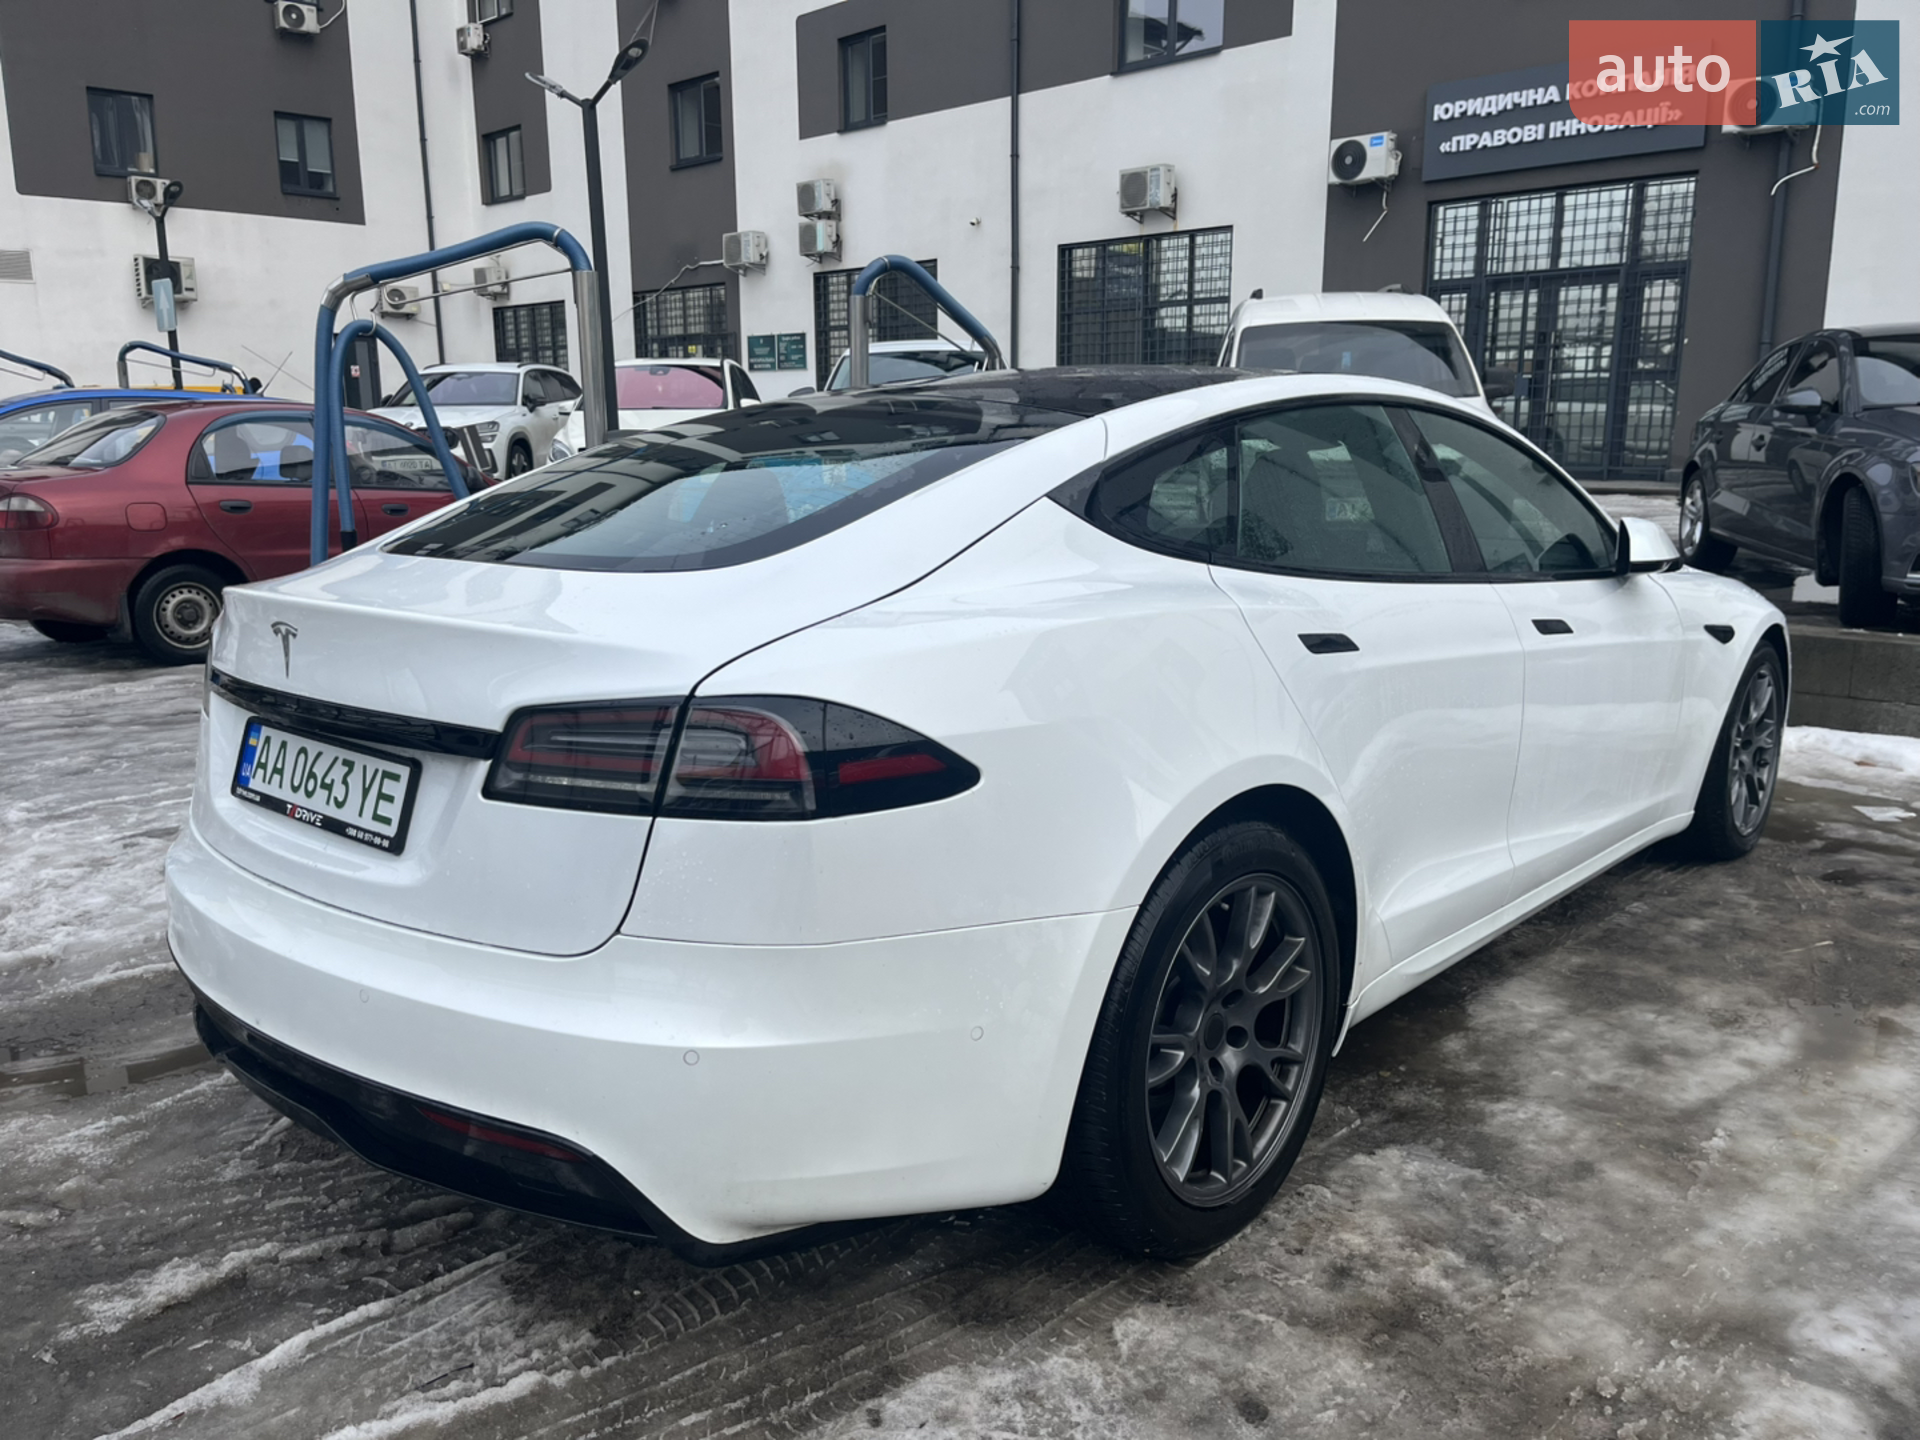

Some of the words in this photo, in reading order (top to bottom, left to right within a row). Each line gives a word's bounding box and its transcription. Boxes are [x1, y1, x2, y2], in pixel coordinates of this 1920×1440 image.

[1432, 85, 1561, 122] ЮРИДИЧНА
[1438, 123, 1545, 154] «ПРАВОВІ
[252, 735, 288, 789] AA
[289, 745, 356, 810] 0643
[357, 764, 402, 827] YE
